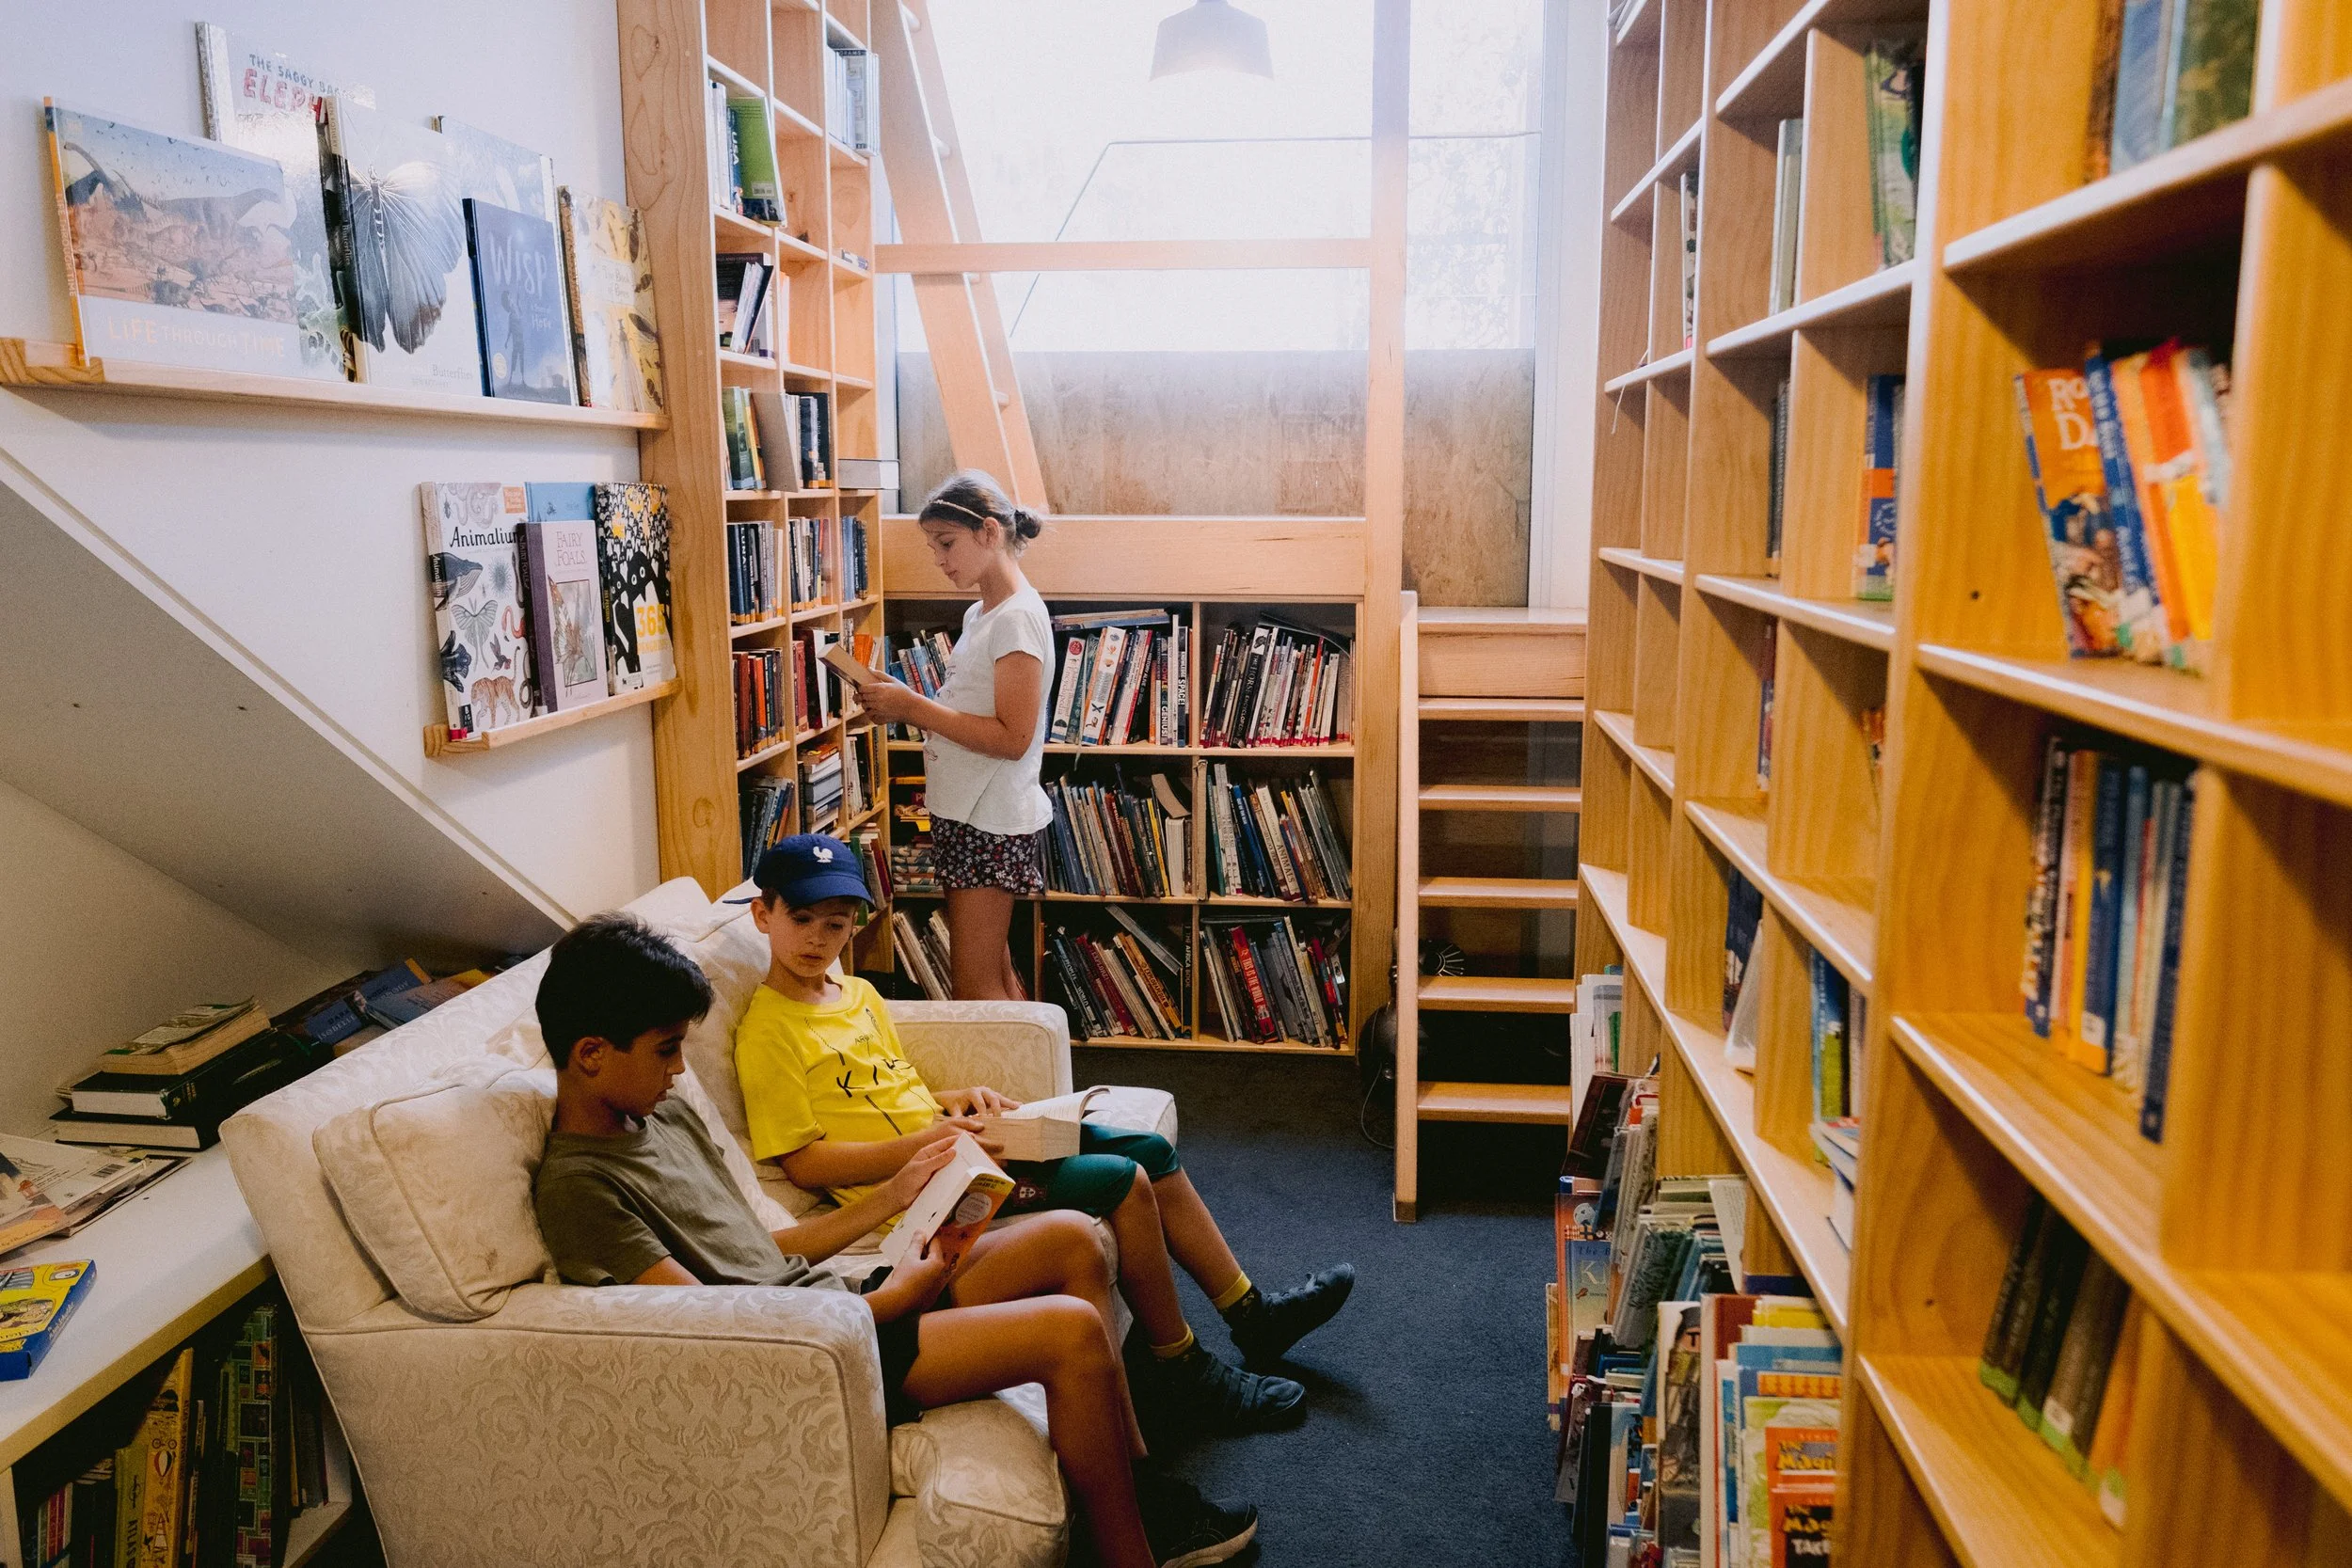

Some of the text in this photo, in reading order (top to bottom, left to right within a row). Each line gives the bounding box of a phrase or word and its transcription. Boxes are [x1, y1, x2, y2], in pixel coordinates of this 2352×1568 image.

[248, 53, 272, 73] THE
[277, 65, 314, 88] SAGGY
[730, 131, 739, 165] USA
[55, 192, 76, 296] LIFE THROUGH TIME
[488, 231, 548, 301] WISP
[107, 316, 286, 358] LIFE THROUGH TIME
[556, 531, 583, 548] FAIRY
[429, 553, 446, 596] Animalium
[554, 549, 588, 567] FOALS
[637, 604, 666, 638] 365
[1056, 664, 1073, 715] Encyclopedia
[1177, 678, 1185, 705] SPACE!
[1244, 665, 1258, 694] HORSE
[1235, 694, 1250, 737] ENCYCLOPEDIA
[1275, 842, 1295, 883] ANIMALS
[1240, 957, 1255, 971] THIS
[1247, 974, 1260, 987] THE
[1249, 984, 1265, 1004] WORLD
[316, 1012, 356, 1041] ISOBELLE
[1776, 1451, 1836, 1471] Magi
[123, 1518, 139, 1557] ATLAS
[1784, 1515, 1833, 1534] Mag
